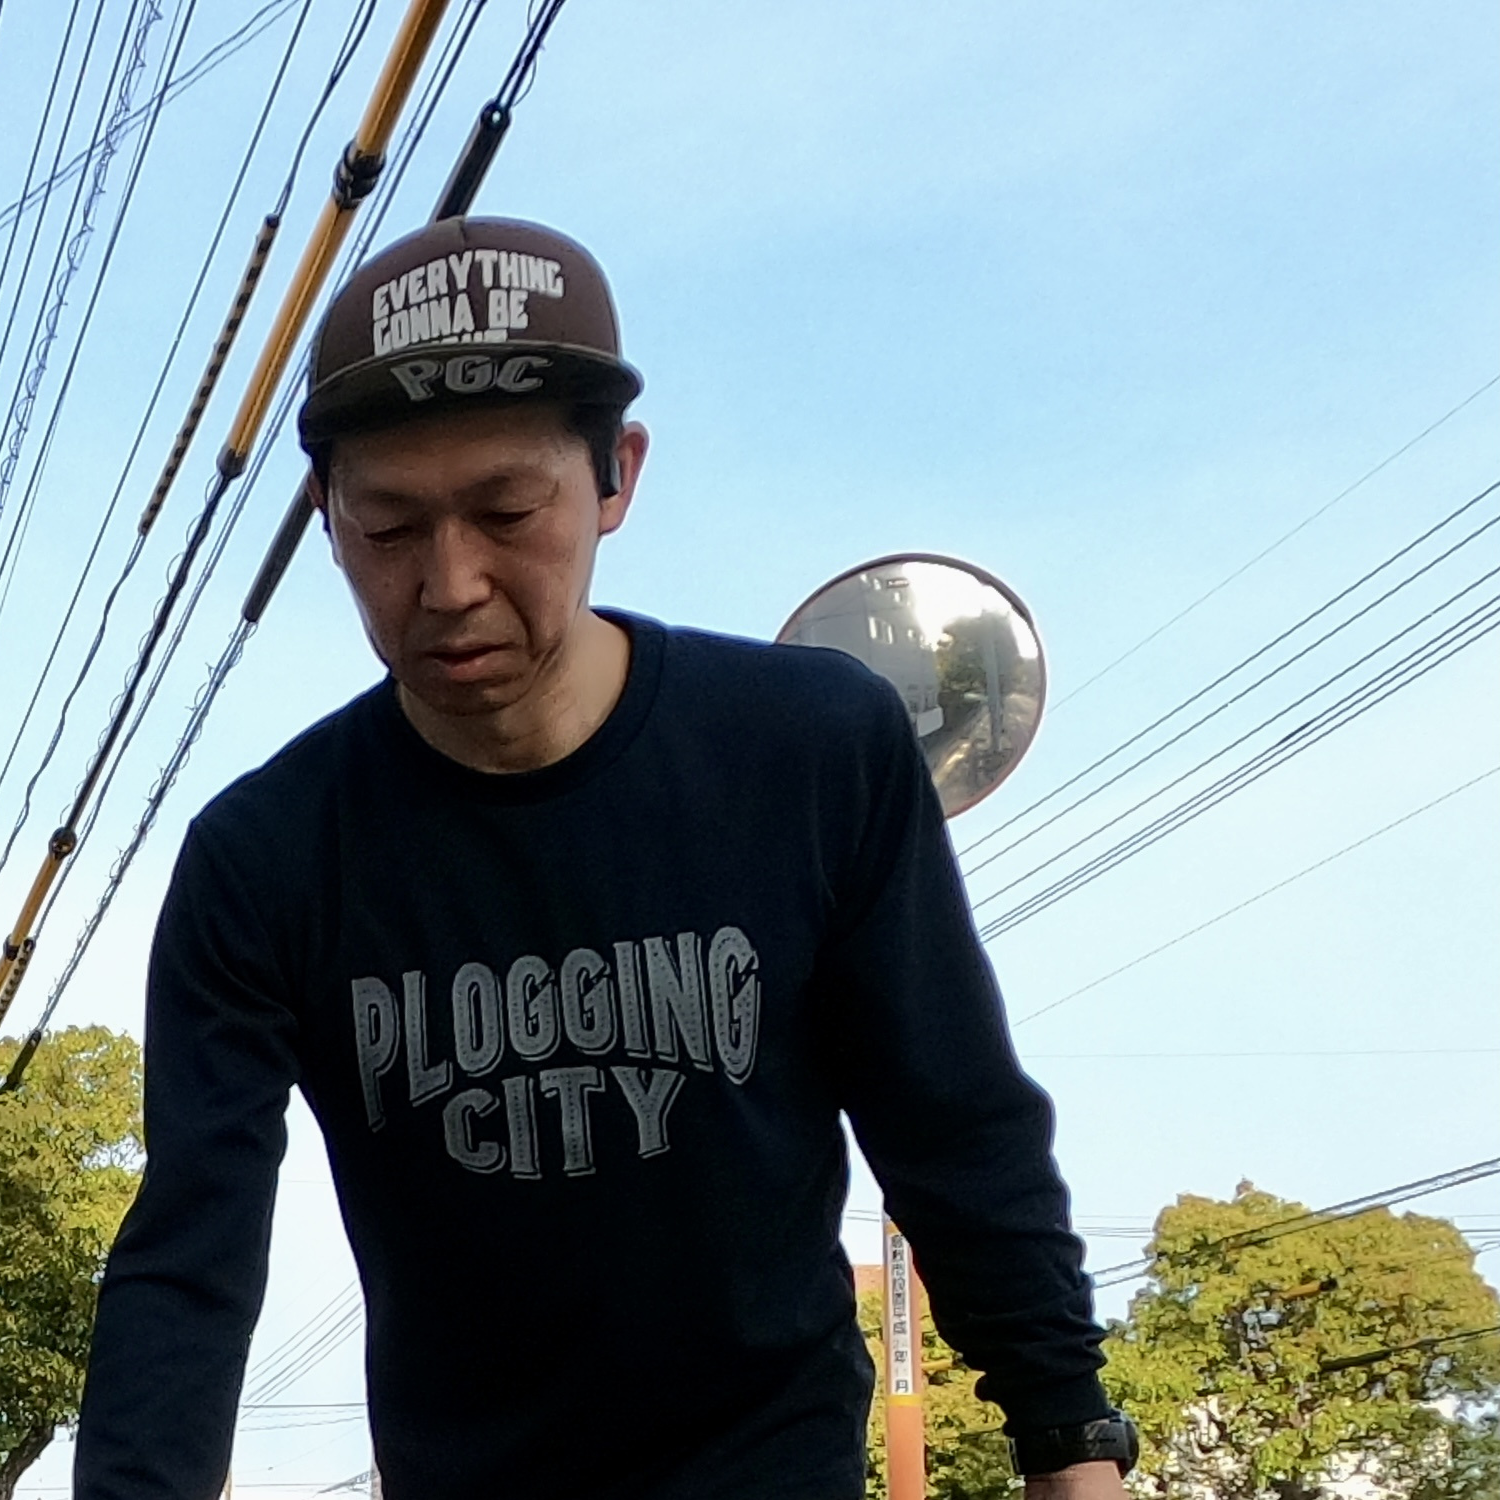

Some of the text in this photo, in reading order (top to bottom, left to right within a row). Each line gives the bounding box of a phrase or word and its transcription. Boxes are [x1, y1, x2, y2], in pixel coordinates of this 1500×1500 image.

[373, 250, 565, 321] EVERYTHING
[373, 289, 529, 356] GONNA BE
[391, 355, 553, 401] PGC
[351, 925, 761, 1133] PLOGGING
[442, 1066, 686, 1180] CITY
